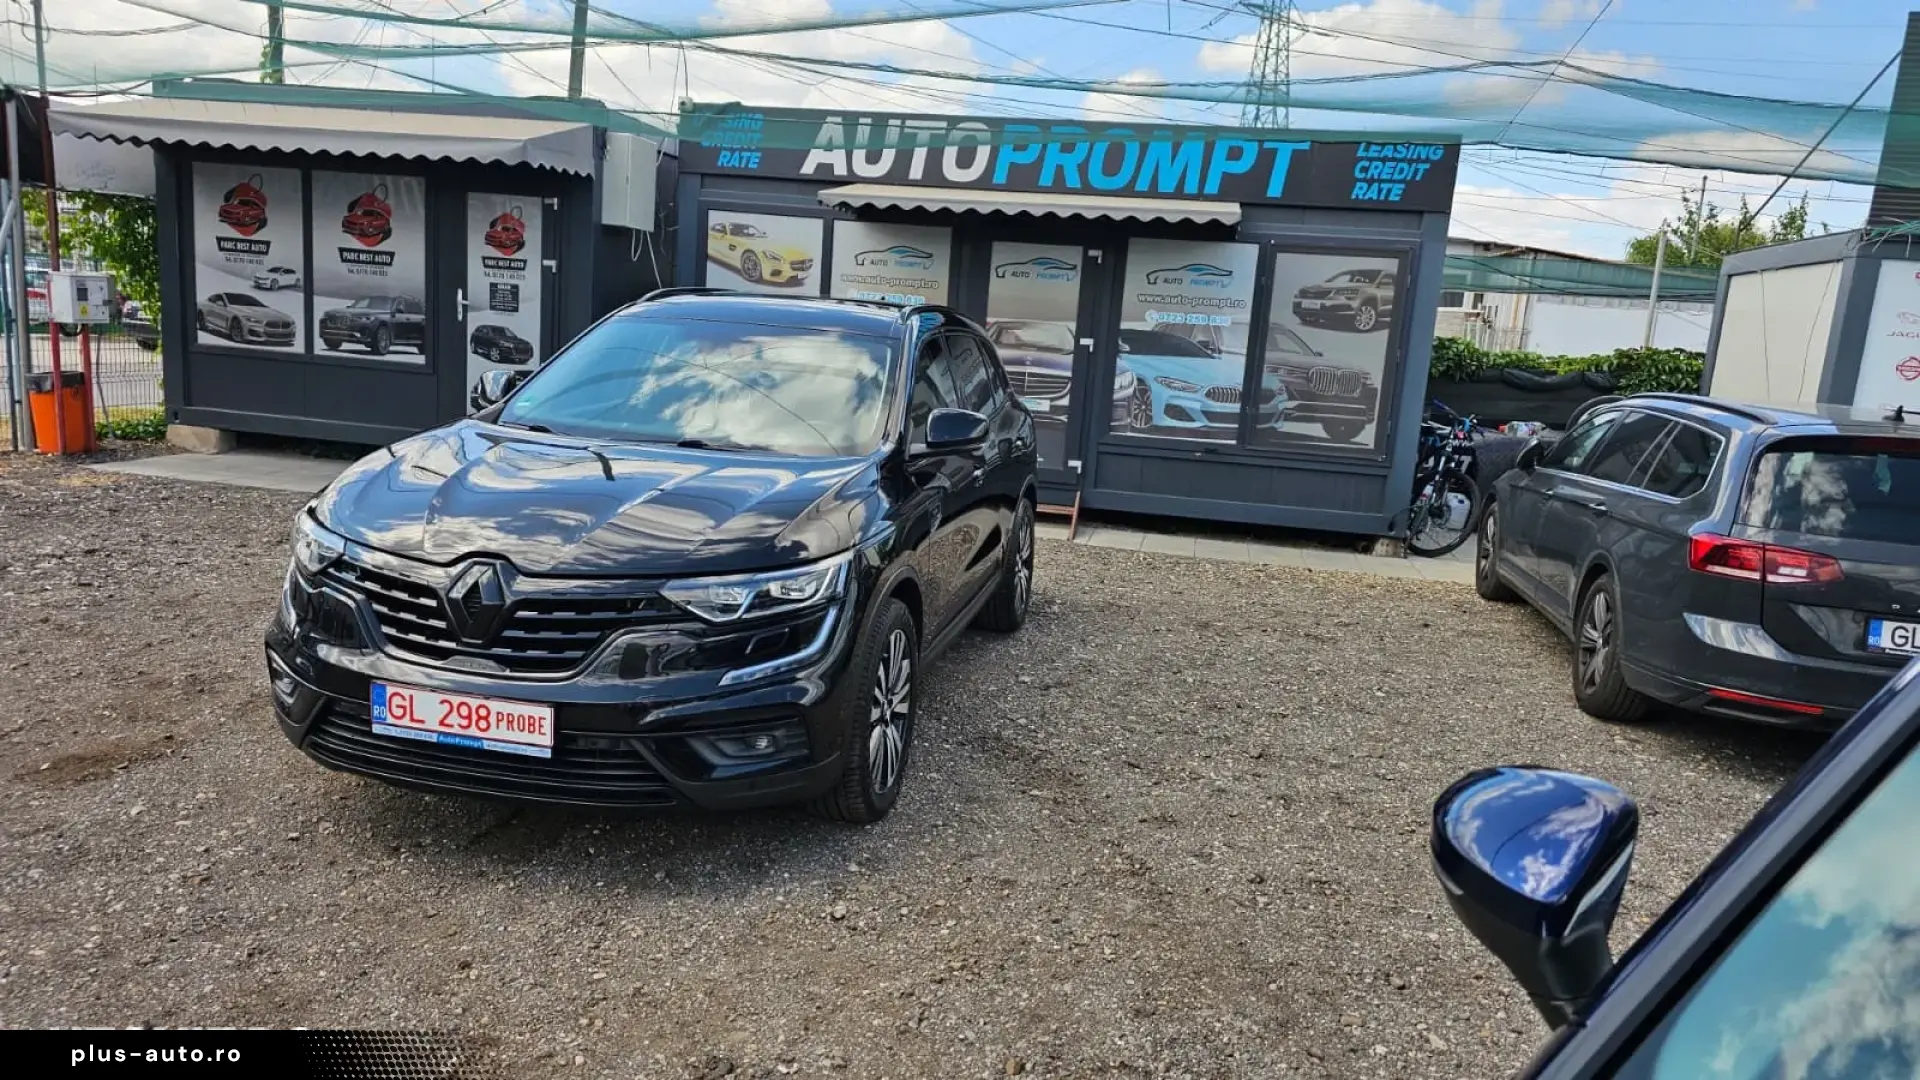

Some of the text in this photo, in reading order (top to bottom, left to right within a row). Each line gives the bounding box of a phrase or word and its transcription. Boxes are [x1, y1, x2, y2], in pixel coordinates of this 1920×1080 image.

[716, 151, 763, 170] RATE
[1356, 142, 1445, 161] LEASING
[1353, 160, 1432, 181] CREDIT
[1350, 181, 1407, 201] RATE
[1011, 270, 1031, 278] AUTO
[1137, 293, 1247, 309] www.auto-prompt.ro
[374, 705, 385, 718] RO
[388, 692, 547, 736] GL 298 PROBE
